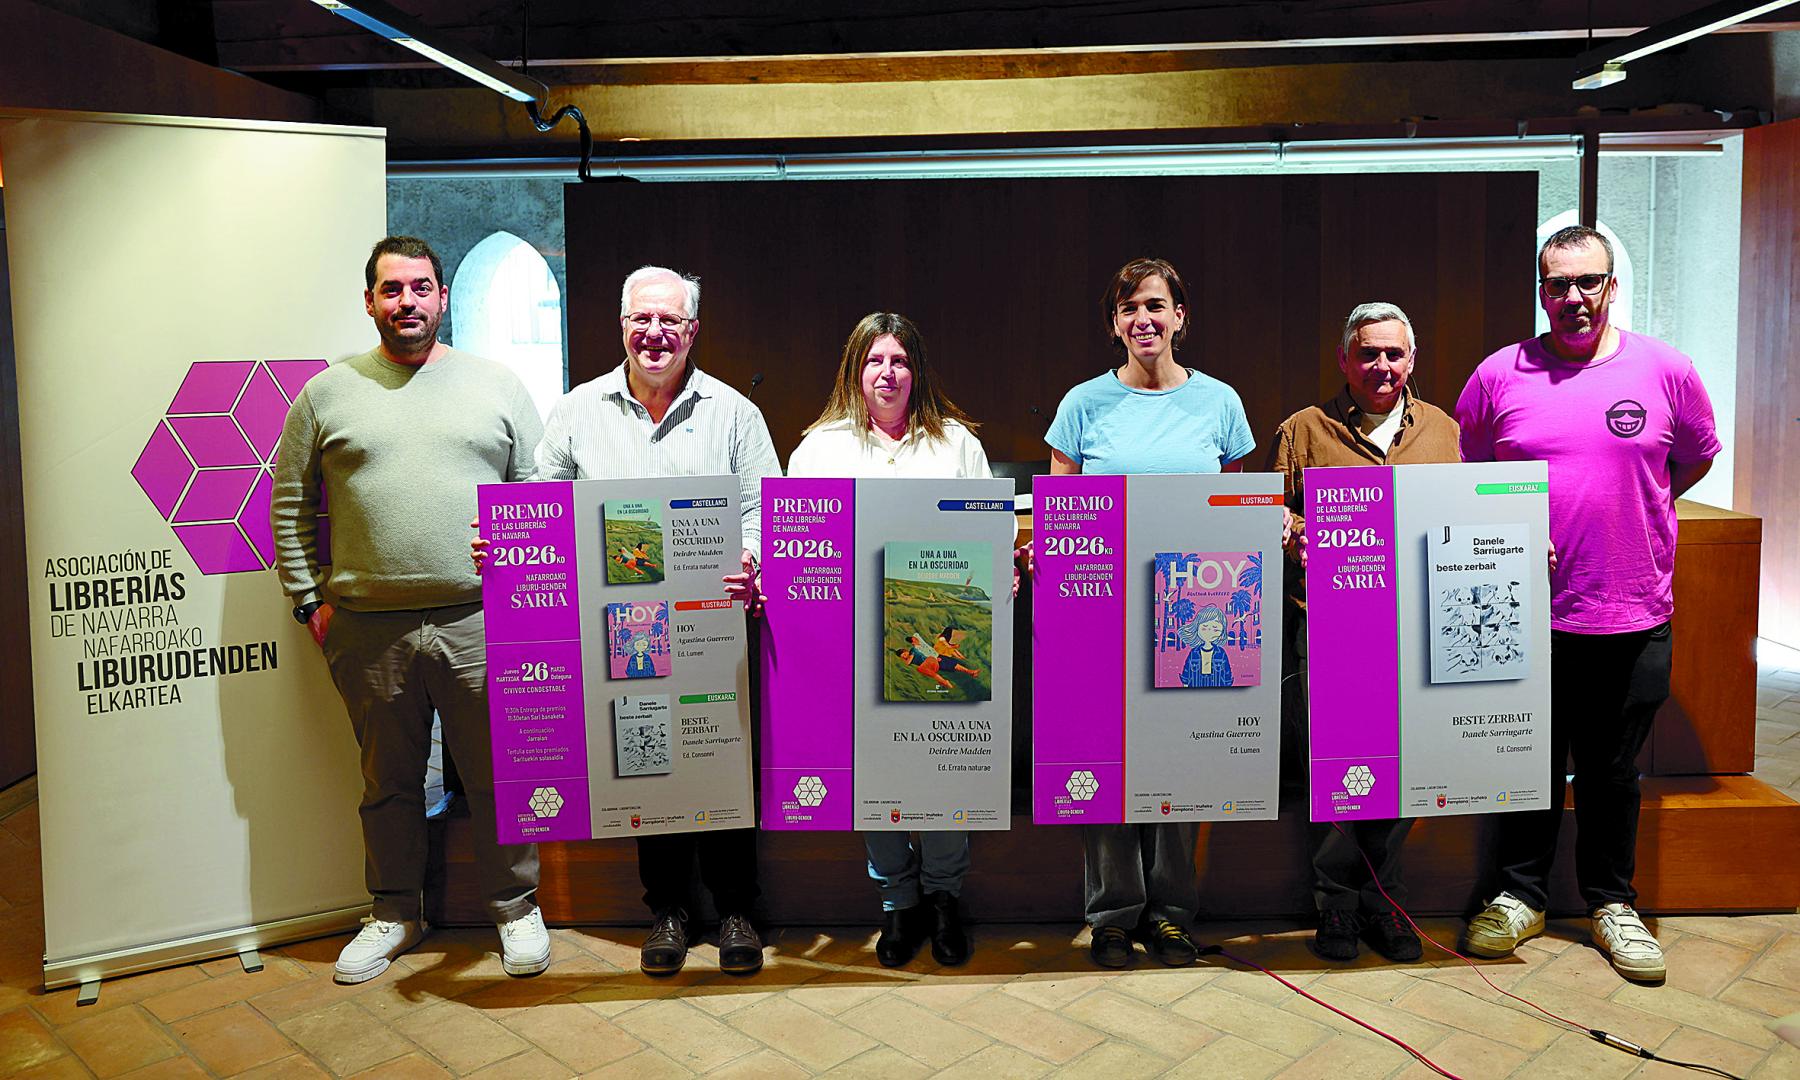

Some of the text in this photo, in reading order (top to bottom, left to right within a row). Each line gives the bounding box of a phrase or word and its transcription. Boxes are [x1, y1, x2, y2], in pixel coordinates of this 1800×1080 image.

[1509, 484, 1539, 492] EUSKARAZ
[1316, 486, 1383, 503] PREMIO
[1044, 495, 1113, 511] PREMIO
[1240, 496, 1274, 505] ILUSTRADO
[773, 498, 842, 514] PREMIO
[1338, 503, 1368, 512] LIBRERÍAS
[491, 503, 563, 520] PREMIO
[795, 514, 825, 523] LIBRERÍAS
[1066, 512, 1097, 521] LIBRERÍAS
[515, 520, 546, 529] LIBRERÍAS
[672, 519, 690, 527] UNA
[701, 518, 720, 526] UNA
[672, 536, 724, 546] OSCURIDAD
[1473, 537, 1504, 545] Danele
[920, 550, 934, 558] UNA
[943, 550, 957, 558] UNA
[1473, 546, 1524, 555] Sarriugarte
[1347, 555, 1385, 563] NAFARROAKO
[45, 550, 172, 578] ASOCIACIÓN DE
[909, 561, 968, 569] EN LA OSCURIDAD
[1338, 564, 1386, 573] LIBURU-DENDEN
[1464, 562, 1496, 571] zerbait
[803, 566, 842, 574] NAFARROAKO
[1170, 560, 1247, 589] HOY
[526, 573, 566, 581] NAFARROAKO
[1332, 574, 1386, 590] SARIA
[50, 569, 186, 612] LIBRERÍAS
[516, 583, 566, 592] LIBURU-DENDEN
[787, 584, 842, 600] SARIA
[1058, 582, 1113, 598] SARIA
[511, 592, 568, 608] SARIA
[616, 606, 659, 623] HOY
[51, 604, 178, 637] DE NAVARRA
[677, 624, 695, 632] HOY
[84, 627, 202, 658] NAFARROAKO
[678, 637, 705, 645] Agustina
[78, 642, 278, 691] LIBURUDENDEN
[522, 662, 549, 681] 26
[87, 684, 182, 715] ELKARTEA
[681, 717, 709, 726] BESTE
[1237, 716, 1261, 726] HOY
[1453, 713, 1533, 726] BESTE ZERBAIT
[681, 725, 719, 734] ZERBAIT
[932, 720, 991, 730] UNA A UNA
[893, 732, 991, 742] EN LA OSCURIDAD
[1189, 730, 1261, 740] Agustina Guerrero
[1462, 728, 1533, 739] Danele Sarriugarte
[929, 747, 991, 756] Deirdre Madden
[1506, 745, 1532, 753] Consonni
[938, 764, 947, 772] Ed.
[948, 764, 966, 772] Errata
